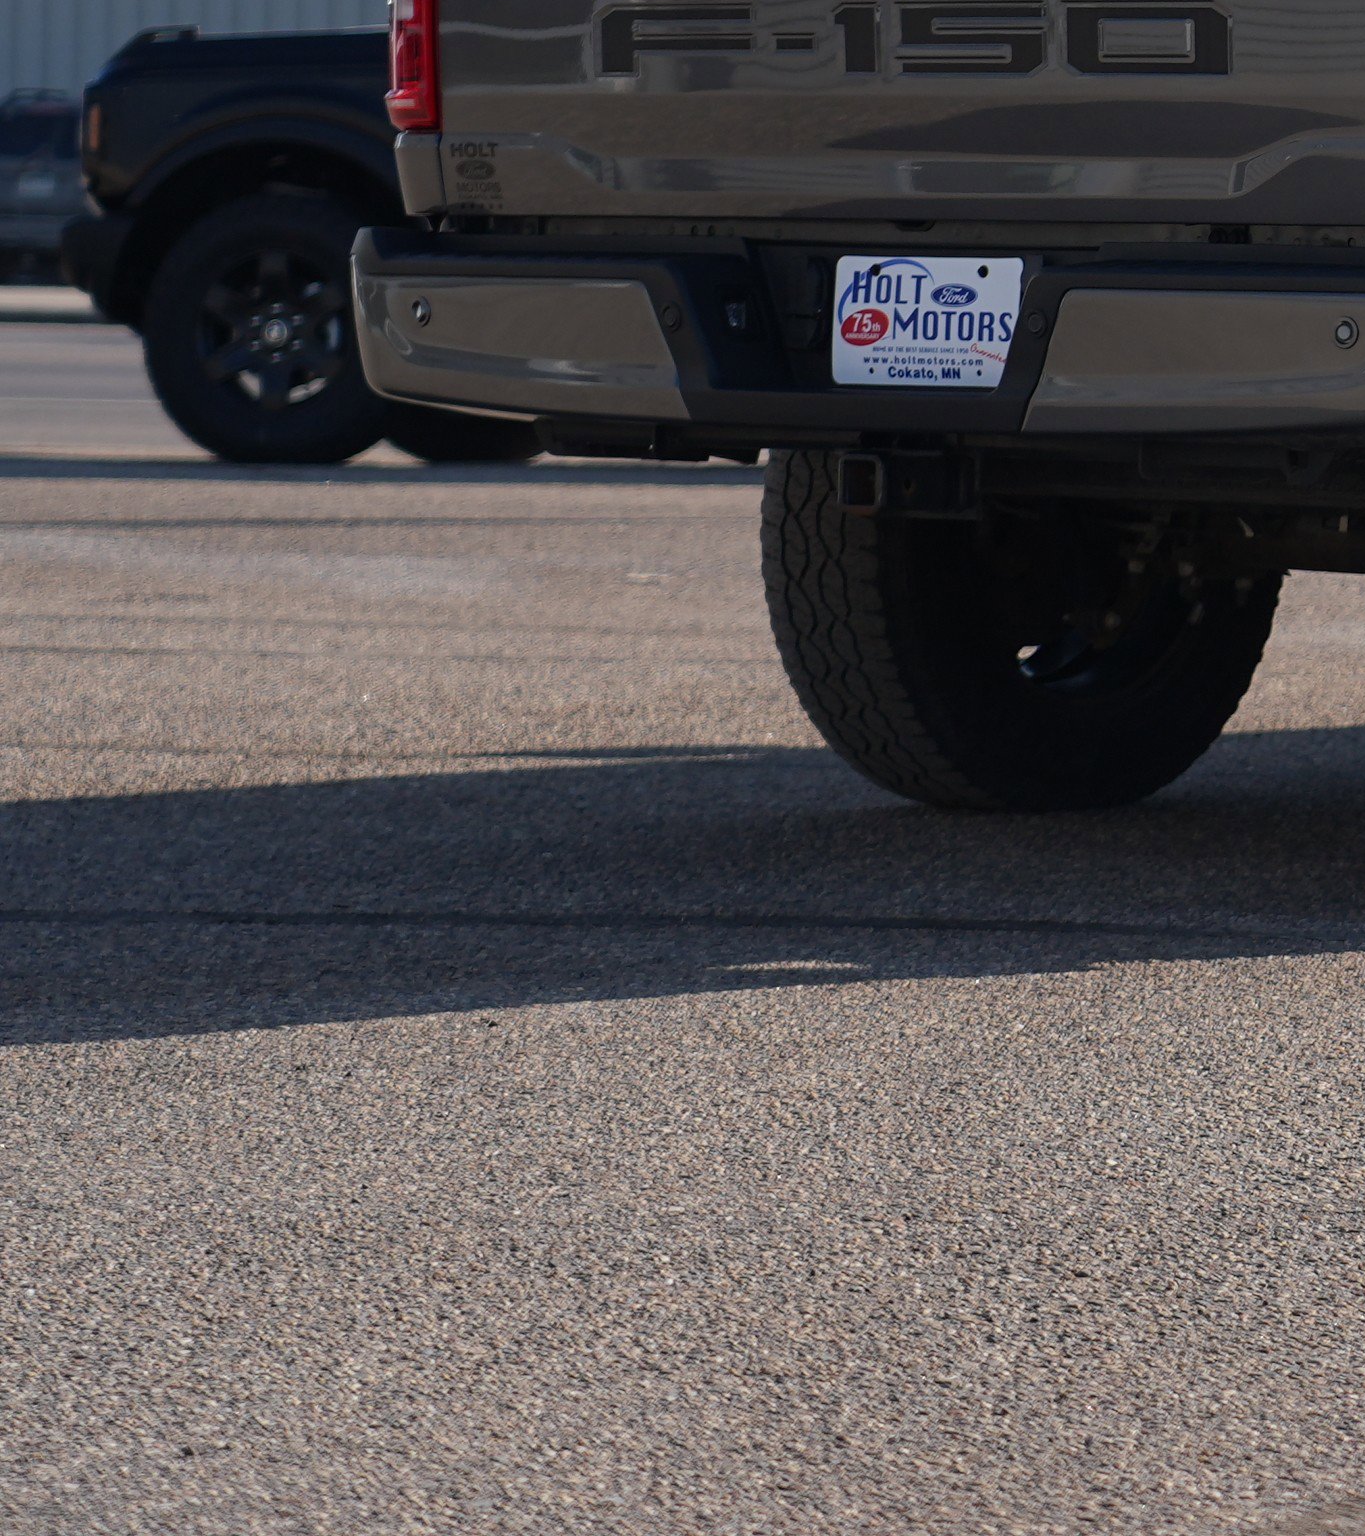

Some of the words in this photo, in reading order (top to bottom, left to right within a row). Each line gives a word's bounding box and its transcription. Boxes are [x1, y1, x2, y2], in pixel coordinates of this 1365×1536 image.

[592, 0, 1234, 78] F-150
[450, 142, 499, 158] HOLT
[851, 269, 928, 305] HOLT
[938, 285, 970, 305] Ford
[852, 312, 881, 333] 75th
[892, 306, 1013, 343] MOTORS
[863, 355, 984, 367] www.holtmotors.com
[888, 366, 938, 382] Cokato,
[941, 367, 962, 380] MN
